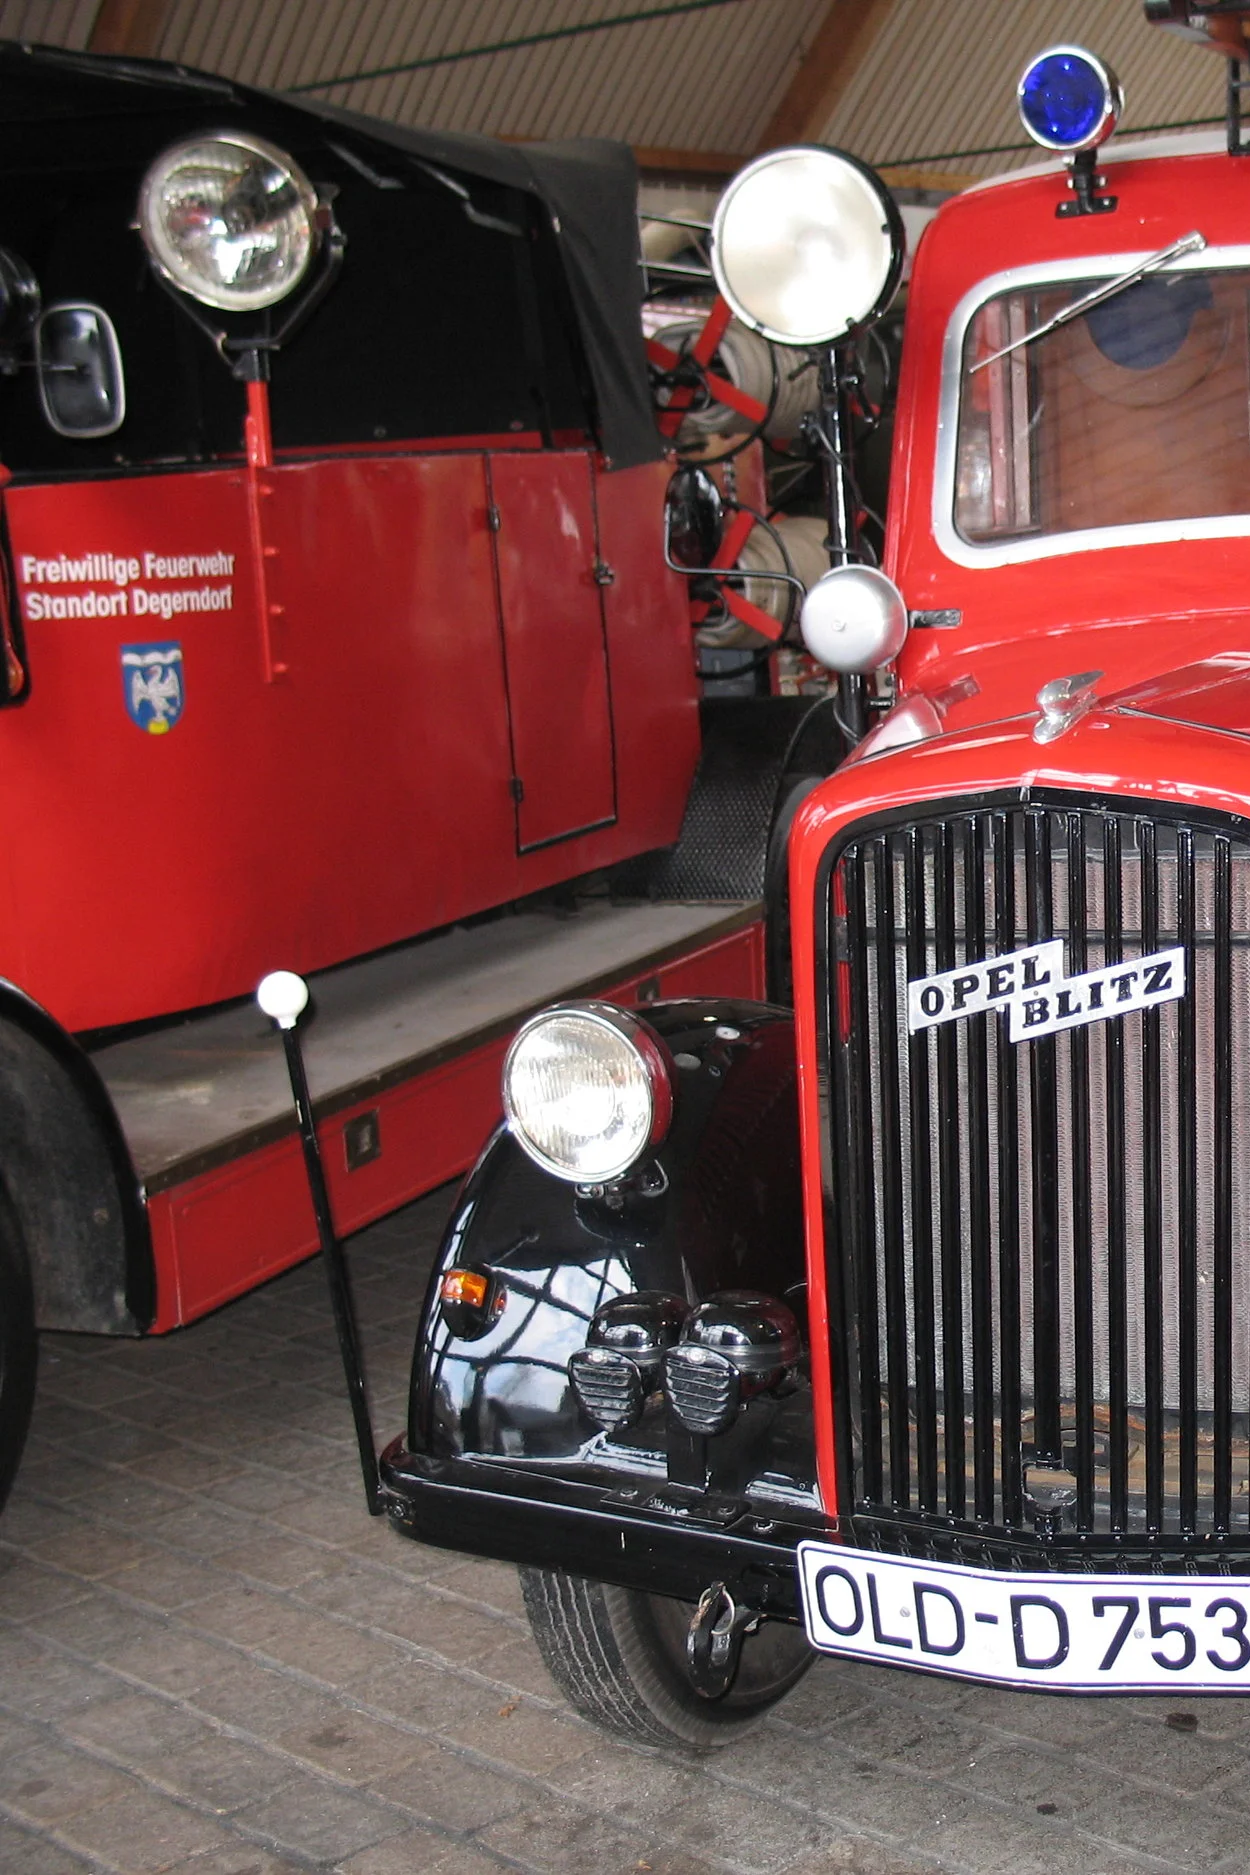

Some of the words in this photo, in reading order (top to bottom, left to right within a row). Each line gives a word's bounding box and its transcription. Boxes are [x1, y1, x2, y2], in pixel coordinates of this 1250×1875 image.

[22, 552, 140, 586] Freiwillige
[144, 550, 235, 579] Feuerwehr
[26, 590, 128, 621] Standort
[133, 584, 232, 619] Degerndorf
[920, 955, 1050, 1017] OPEL
[1022, 960, 1173, 1029] BLITZ
[814, 1565, 1069, 1670] OLD-D
